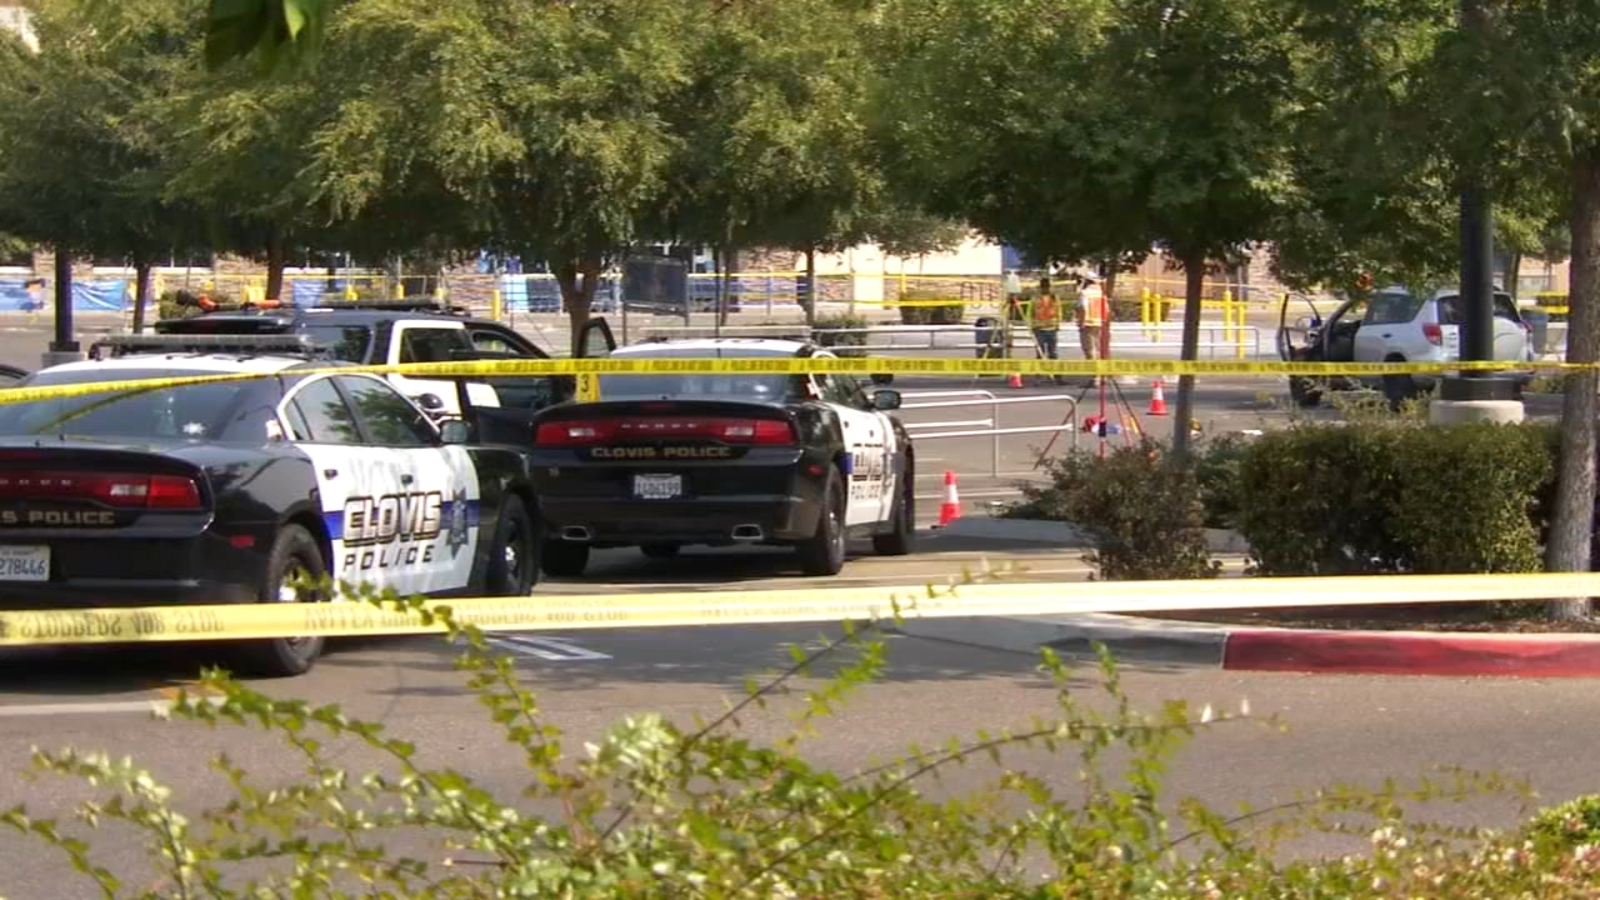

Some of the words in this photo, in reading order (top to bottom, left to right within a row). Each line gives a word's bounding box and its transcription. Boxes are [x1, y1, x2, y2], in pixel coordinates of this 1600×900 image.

[591, 447, 655, 459] CLOVIS
[664, 446, 730, 458] POLICE
[29, 510, 116, 525] POLICE
[344, 491, 441, 547] CLOVIS
[343, 545, 434, 571] POLICE
